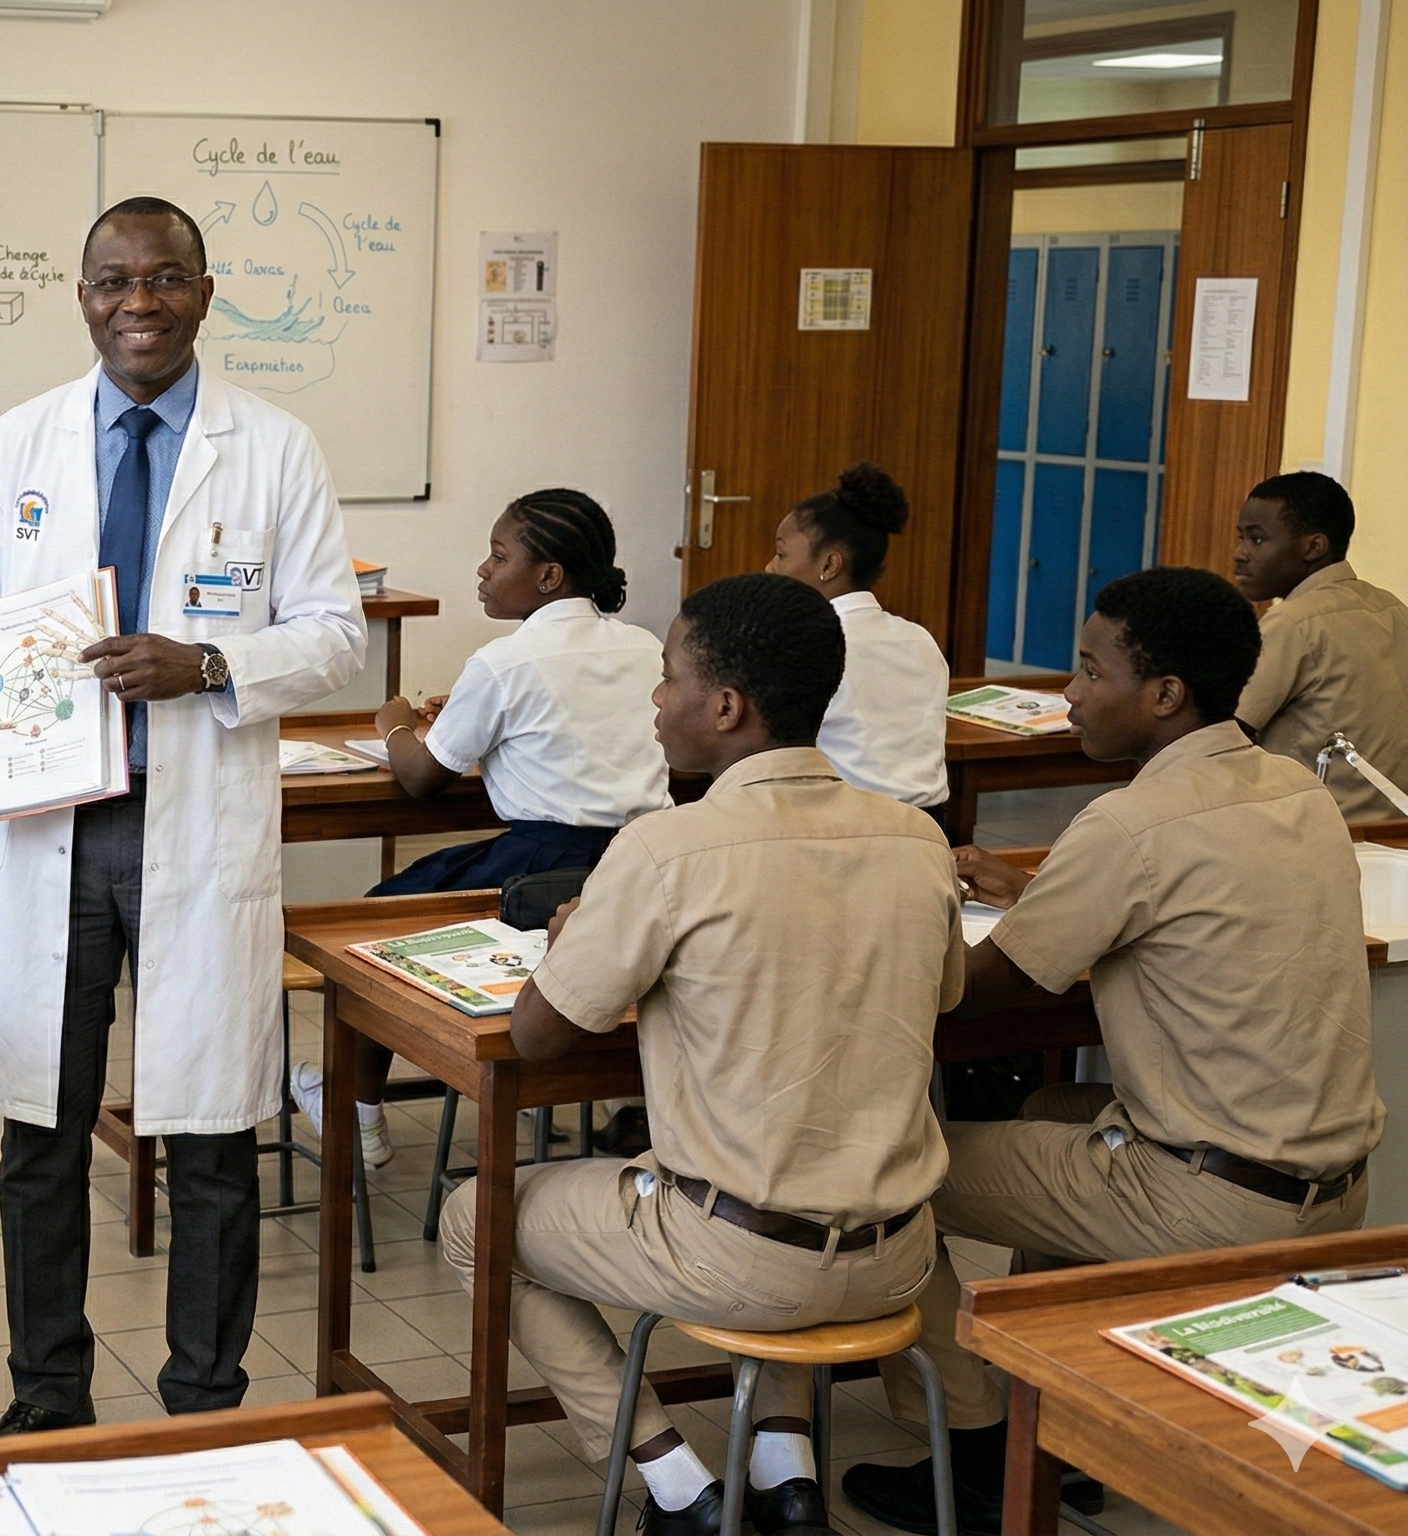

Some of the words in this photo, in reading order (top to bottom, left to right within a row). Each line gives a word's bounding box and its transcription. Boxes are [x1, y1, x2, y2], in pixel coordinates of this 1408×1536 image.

[193, 137, 246, 177] Cycle
[256, 142, 278, 164] de
[289, 140, 340, 165] l'eau
[343, 213, 379, 236] Cycle
[385, 213, 401, 231] de
[357, 234, 396, 252] l'eau
[0, 266, 14, 280] de
[16, 527, 40, 541] SVT
